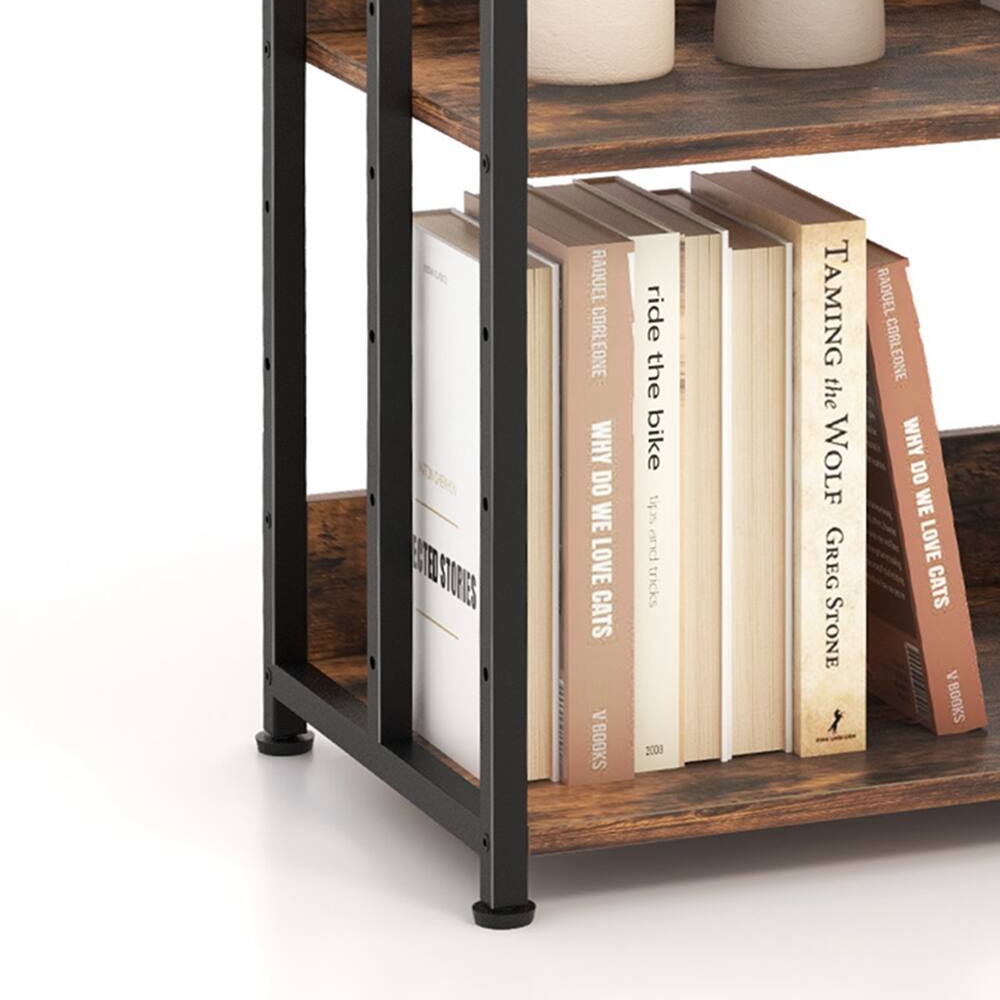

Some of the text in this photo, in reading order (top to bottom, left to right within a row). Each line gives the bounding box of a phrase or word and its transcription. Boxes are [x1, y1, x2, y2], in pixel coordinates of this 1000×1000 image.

[592, 249, 607, 378] RAQUEL CORLEONE
[647, 285, 664, 471] ride the bike
[824, 239, 849, 505] TAMING the WOLF
[878, 267, 908, 382] RAQUEL CORLEONE
[591, 420, 613, 640] WHY DO WE LOVE CATS
[647, 495, 660, 609] tips and tricks
[903, 416, 950, 610] WHY DO WE LOVE CATS
[440, 553, 477, 611] STORIES
[825, 526, 844, 669] GREG STONE
[592, 723, 607, 771] BOOKS
[947, 682, 966, 724] BOOKS
